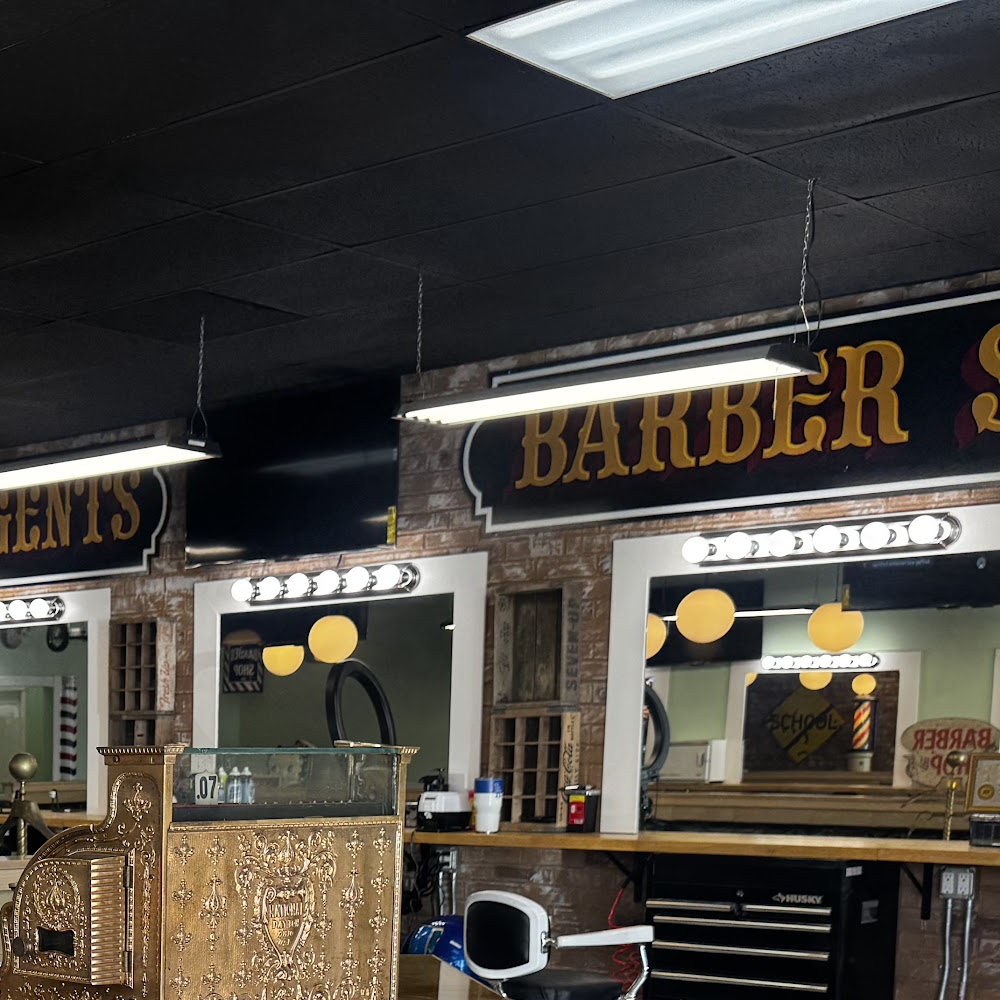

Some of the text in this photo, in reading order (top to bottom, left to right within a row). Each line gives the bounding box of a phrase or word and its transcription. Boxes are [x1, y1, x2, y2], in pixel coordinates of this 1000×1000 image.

[515, 341, 909, 489] BARBER
[196, 775, 217, 799] .07
[786, 894, 824, 904] HUSKY
